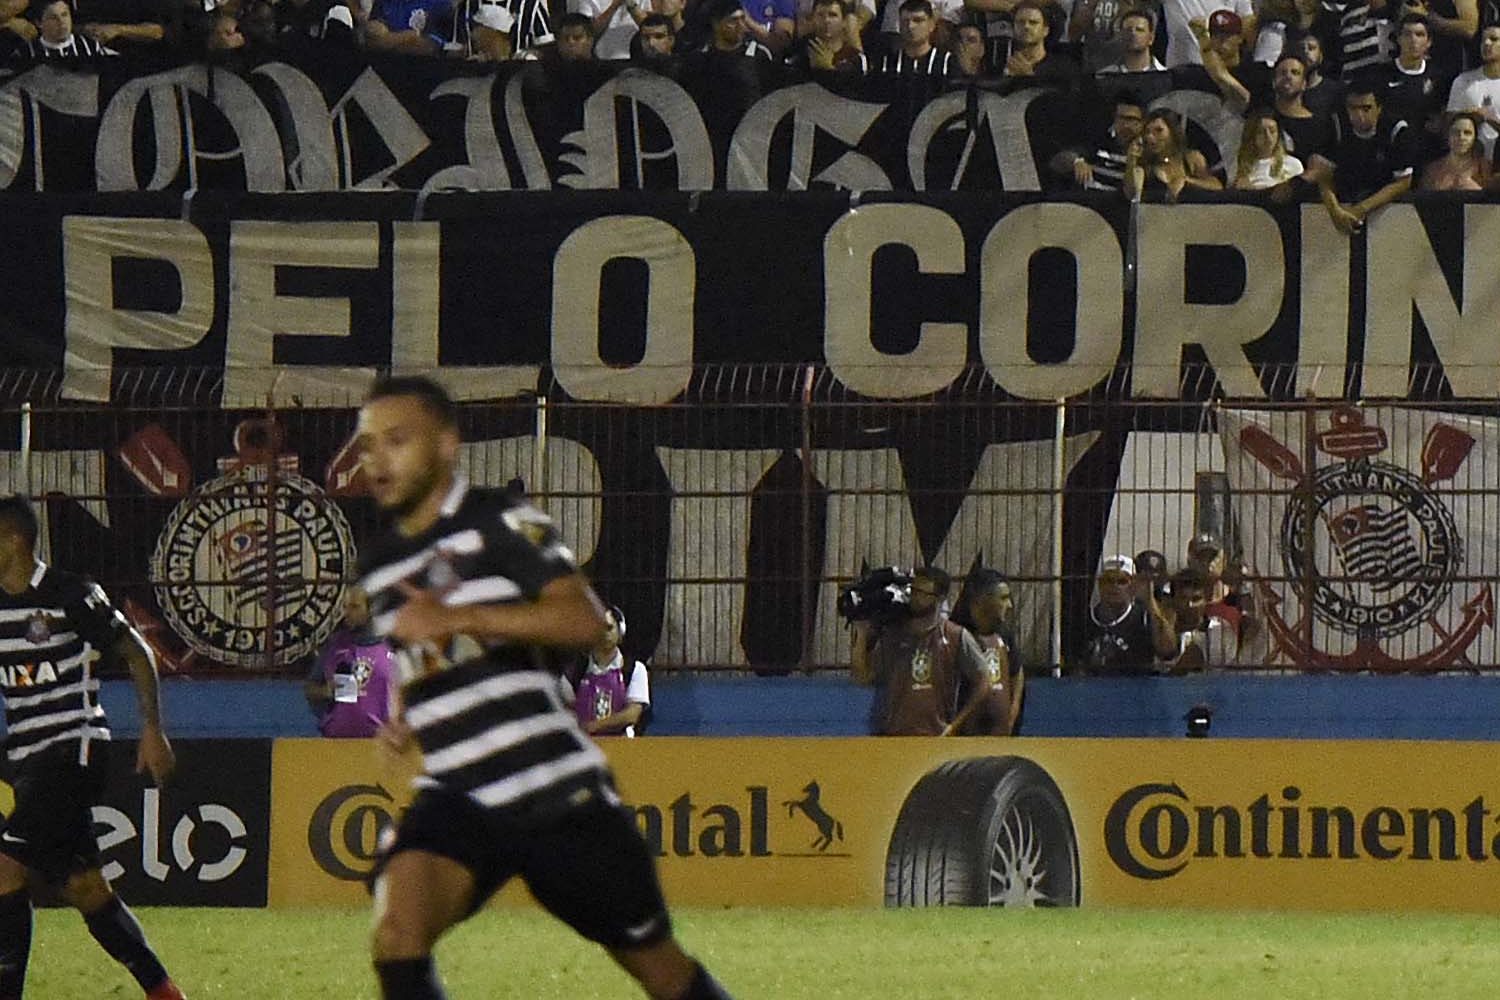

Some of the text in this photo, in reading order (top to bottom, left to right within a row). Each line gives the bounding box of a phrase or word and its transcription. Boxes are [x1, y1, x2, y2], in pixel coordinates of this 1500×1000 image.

[61, 213, 696, 410] PELO
[91, 787, 248, 882] elo
[308, 783, 773, 882] Contal
